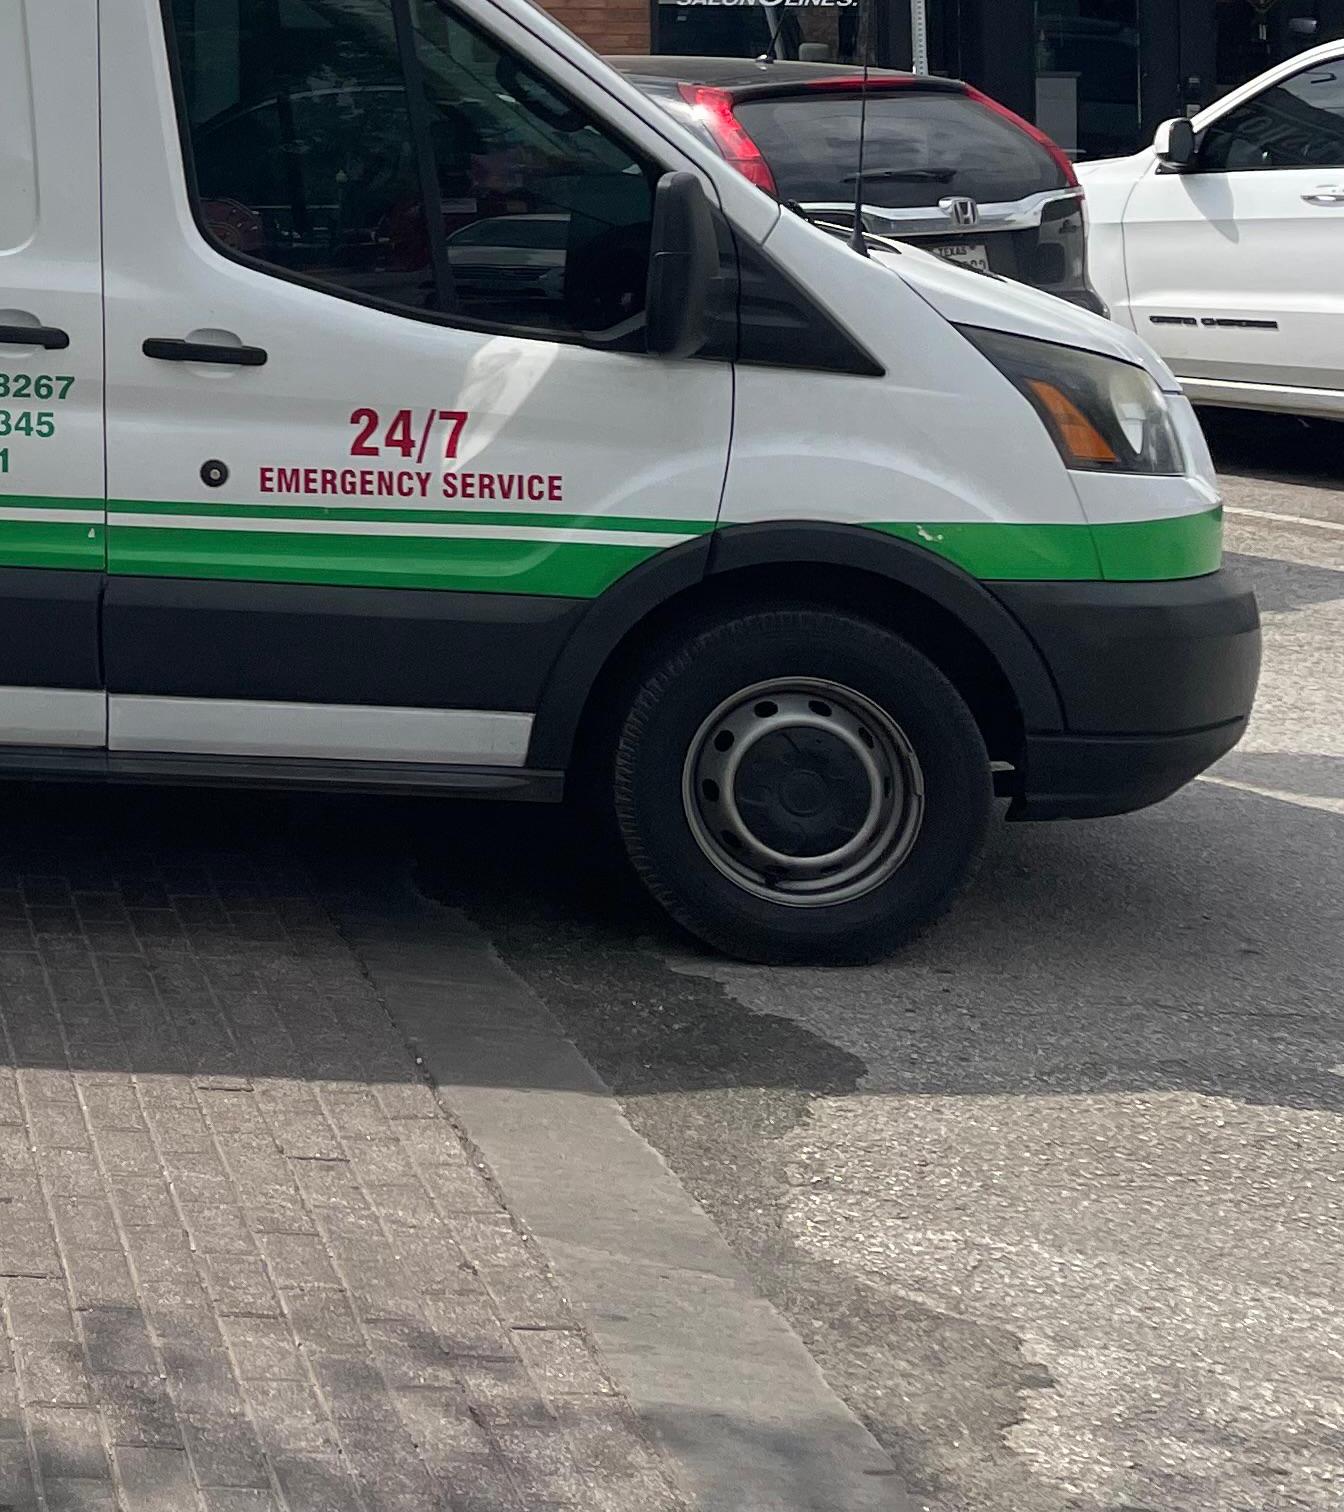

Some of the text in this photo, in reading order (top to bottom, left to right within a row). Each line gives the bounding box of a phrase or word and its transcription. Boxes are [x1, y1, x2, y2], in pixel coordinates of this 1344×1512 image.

[350, 408, 468, 462] 24/7
[261, 467, 562, 501] EMERGENCY SERVICE
